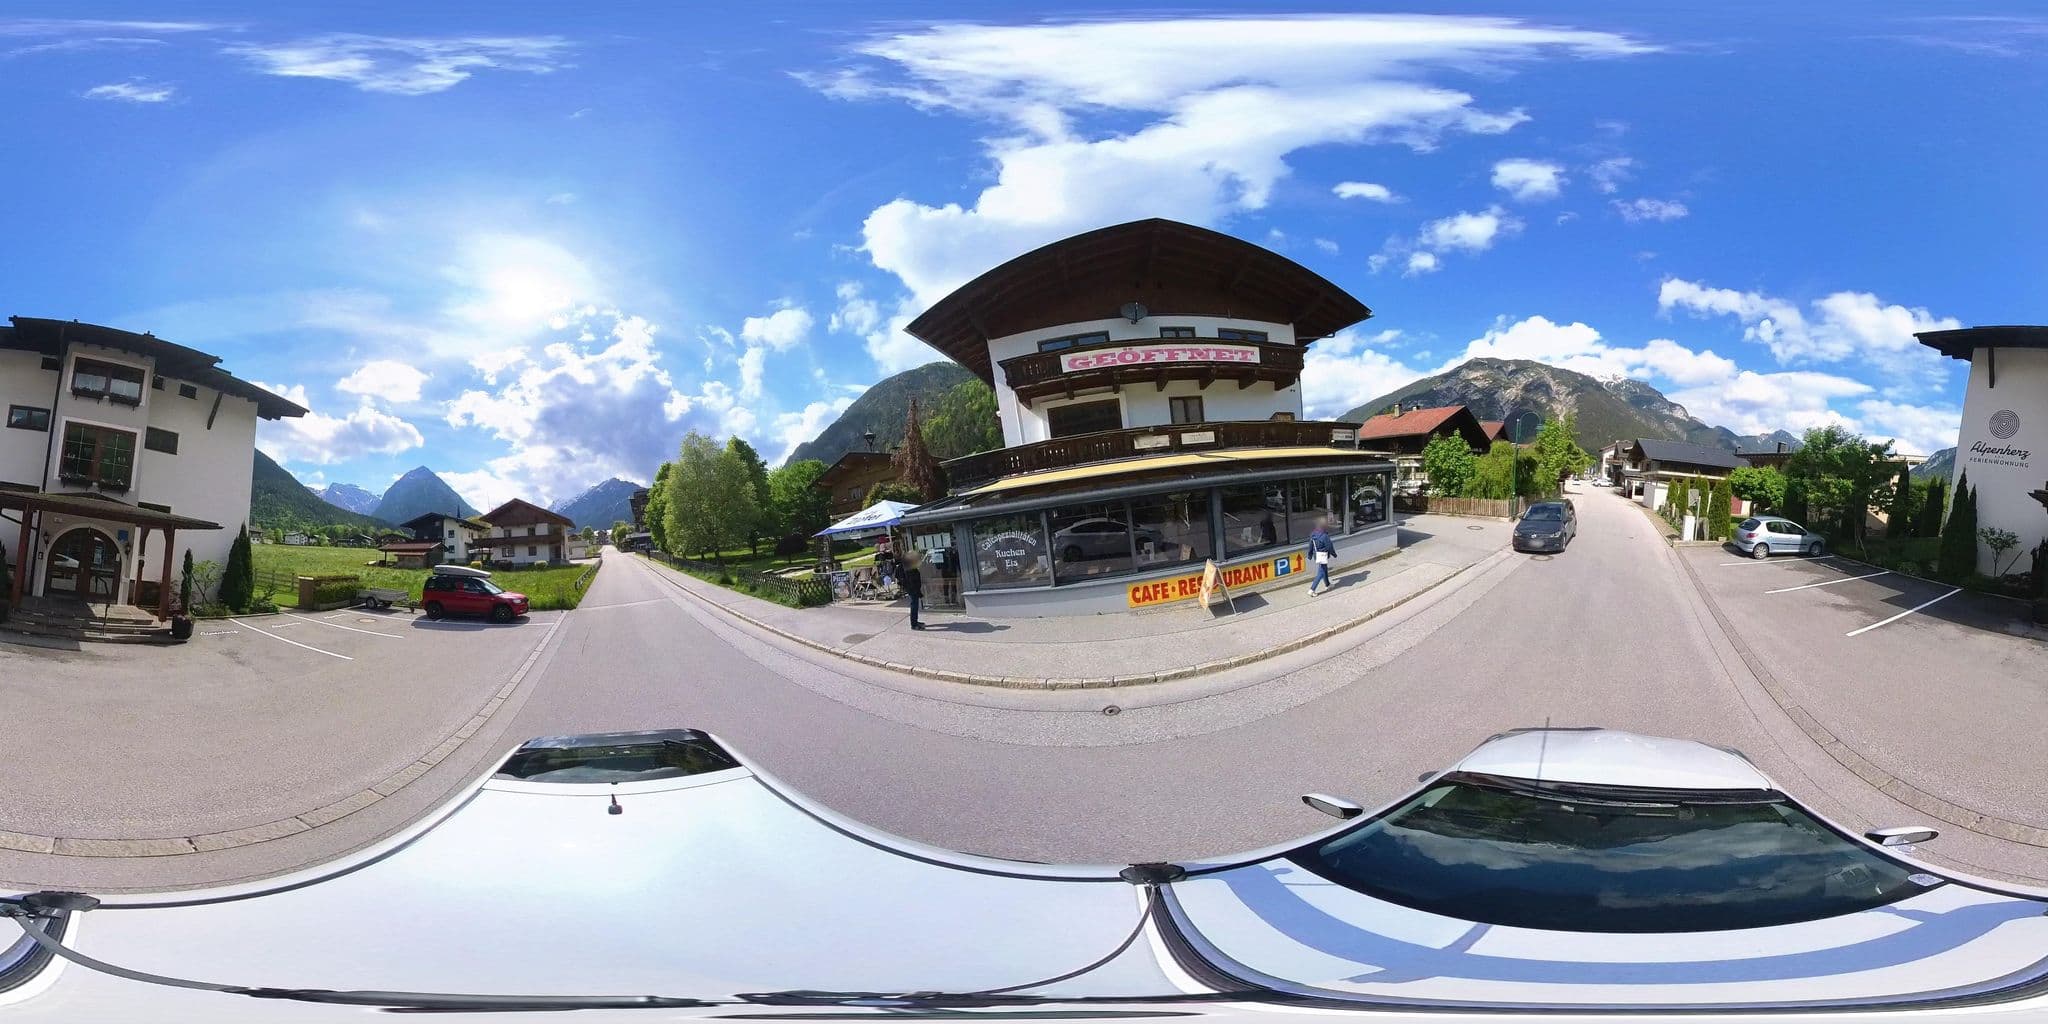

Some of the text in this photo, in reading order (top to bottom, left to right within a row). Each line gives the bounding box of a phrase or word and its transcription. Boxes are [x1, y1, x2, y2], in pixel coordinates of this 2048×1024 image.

[1067, 347, 1255, 370] GEÖFFNET
[1969, 440, 2031, 460] Alpenherz
[1969, 456, 2029, 468] FERIENWOHNUNG
[995, 549, 1026, 558] Kuchen
[1131, 582, 1170, 604] CAFE
